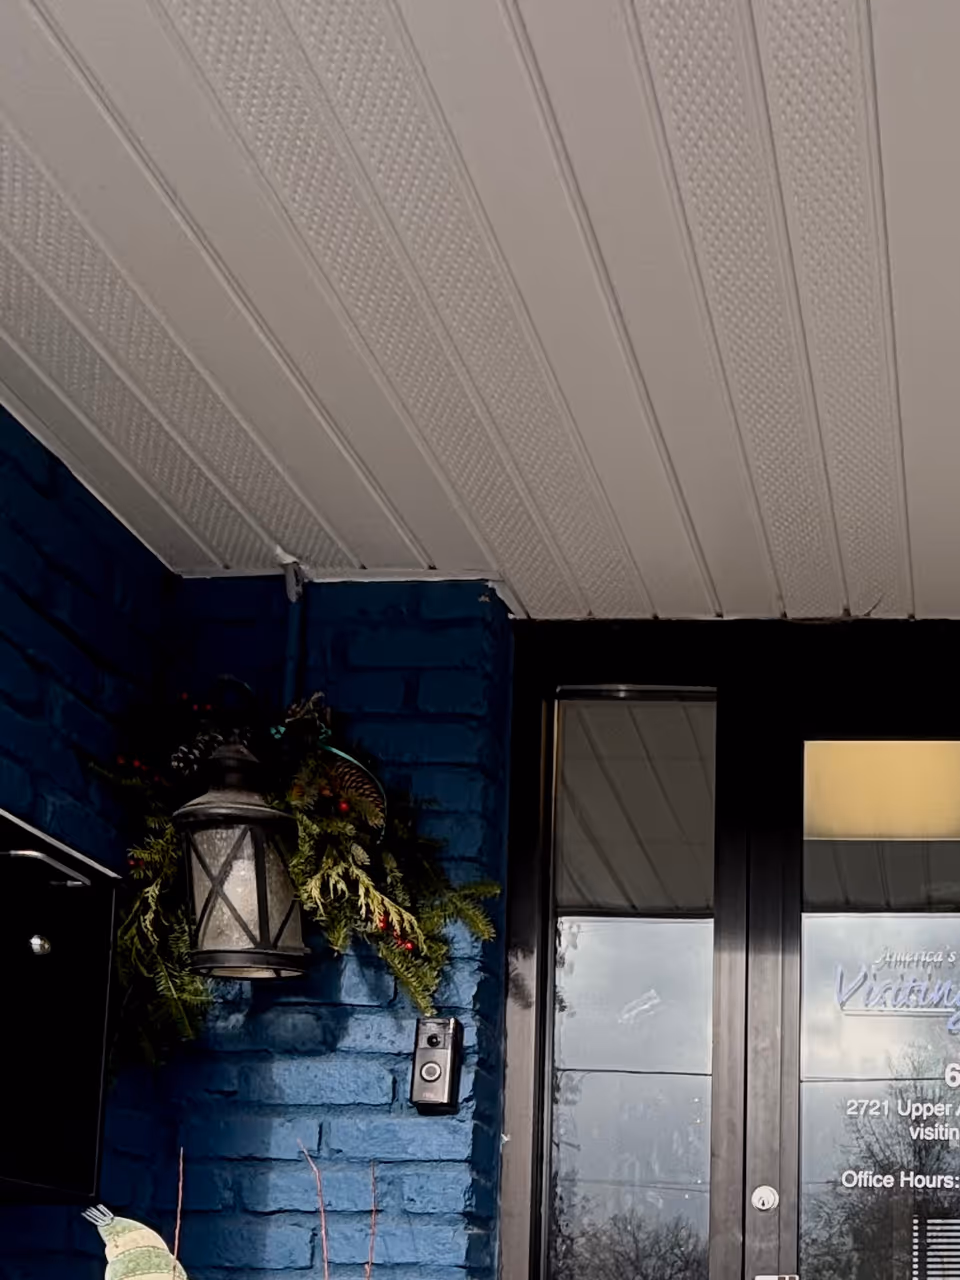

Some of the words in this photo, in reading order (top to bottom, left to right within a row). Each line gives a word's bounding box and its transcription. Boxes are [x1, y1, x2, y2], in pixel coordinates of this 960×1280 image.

[874, 945, 957, 965] America's
[846, 1099, 890, 1116] 2721
[897, 1099, 953, 1120] Upper
[841, 1170, 895, 1188] Office
[900, 1171, 959, 1189] Hours:
